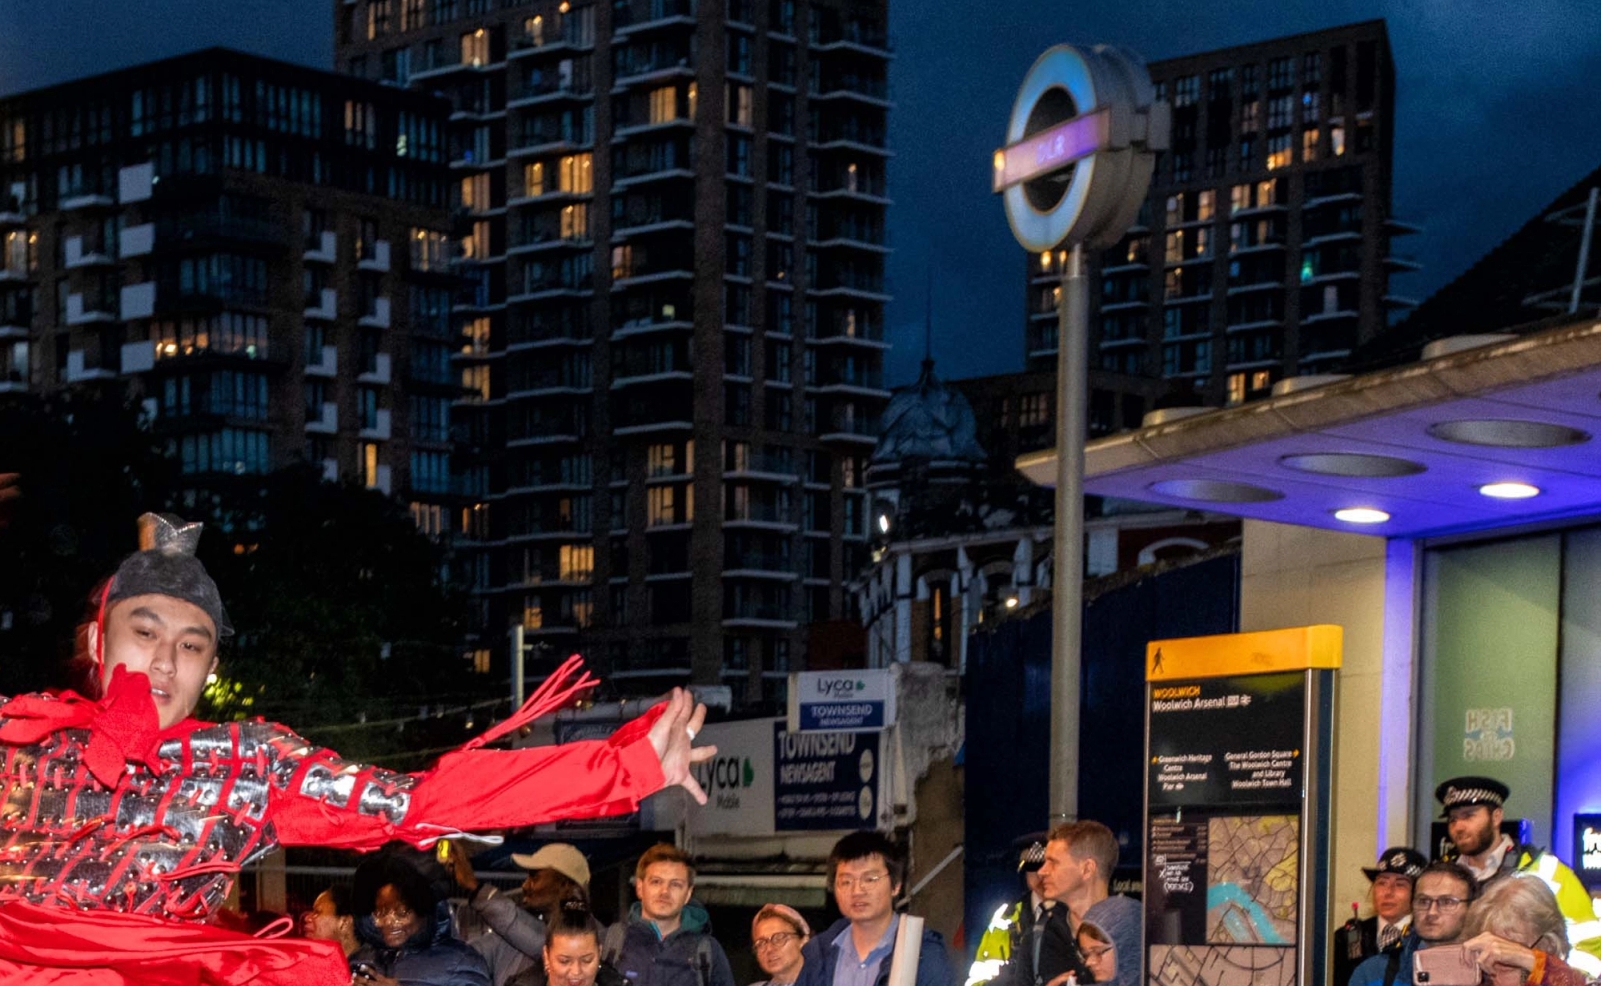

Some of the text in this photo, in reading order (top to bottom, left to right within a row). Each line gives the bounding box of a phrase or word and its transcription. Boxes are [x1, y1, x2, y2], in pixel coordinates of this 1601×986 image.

[817, 678, 854, 695] Lyca
[1153, 686, 1201, 699] WOOLWICH
[1153, 699, 1193, 712] Woolwich
[1194, 696, 1226, 710] Arsenal
[811, 704, 873, 718] TOWNSEND
[819, 717, 864, 726] NEWSAGENT
[778, 733, 856, 760] TOWNSEND
[1225, 750, 1291, 761] General Gordon Square
[1241, 761, 1270, 769] Woolwich
[1271, 760, 1292, 768] Centre
[780, 761, 836, 784] NEWSAGENT
[1186, 772, 1207, 780] Arsenal
[1264, 770, 1286, 778] Library
[1232, 780, 1261, 788] Woolwich
[1262, 779, 1279, 787] Town
